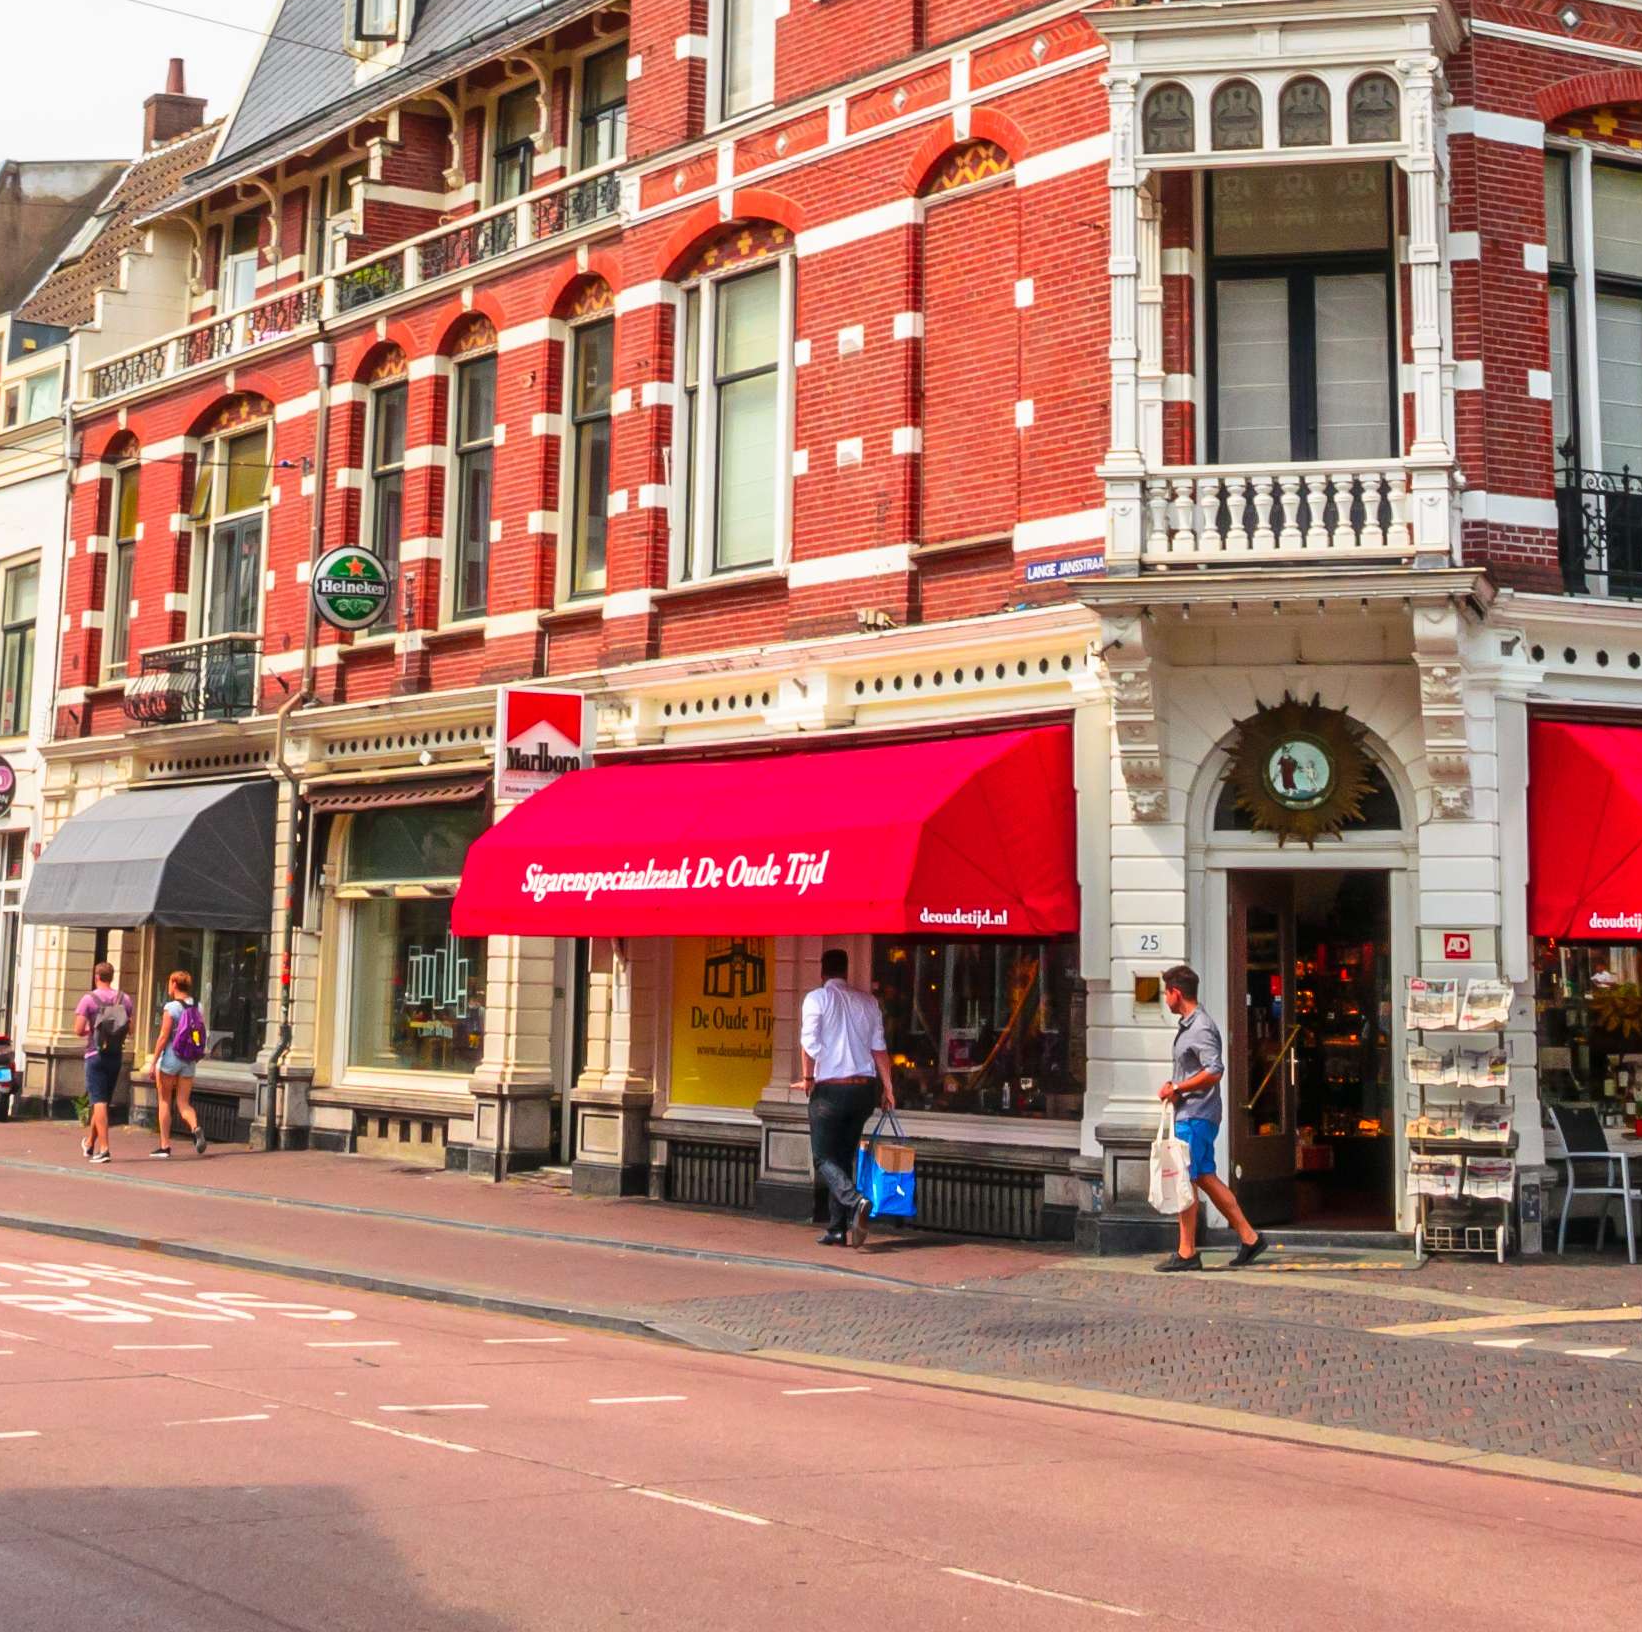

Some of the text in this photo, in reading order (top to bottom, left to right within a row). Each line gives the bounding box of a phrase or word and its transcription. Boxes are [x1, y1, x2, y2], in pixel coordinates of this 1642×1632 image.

[1027, 555, 1105, 580] LANGE JANSSTRAA
[320, 579, 385, 596] Heineken
[506, 742, 580, 775] Marlboro
[521, 849, 831, 902] Sigarenspeciaalzaak De Oude Tijd
[919, 906, 1008, 929] deoudetijd.nl
[1140, 934, 1159, 950] 25
[1446, 936, 1469, 952] AD
[691, 1006, 710, 1029] De
[712, 1005, 749, 1030] Oude
